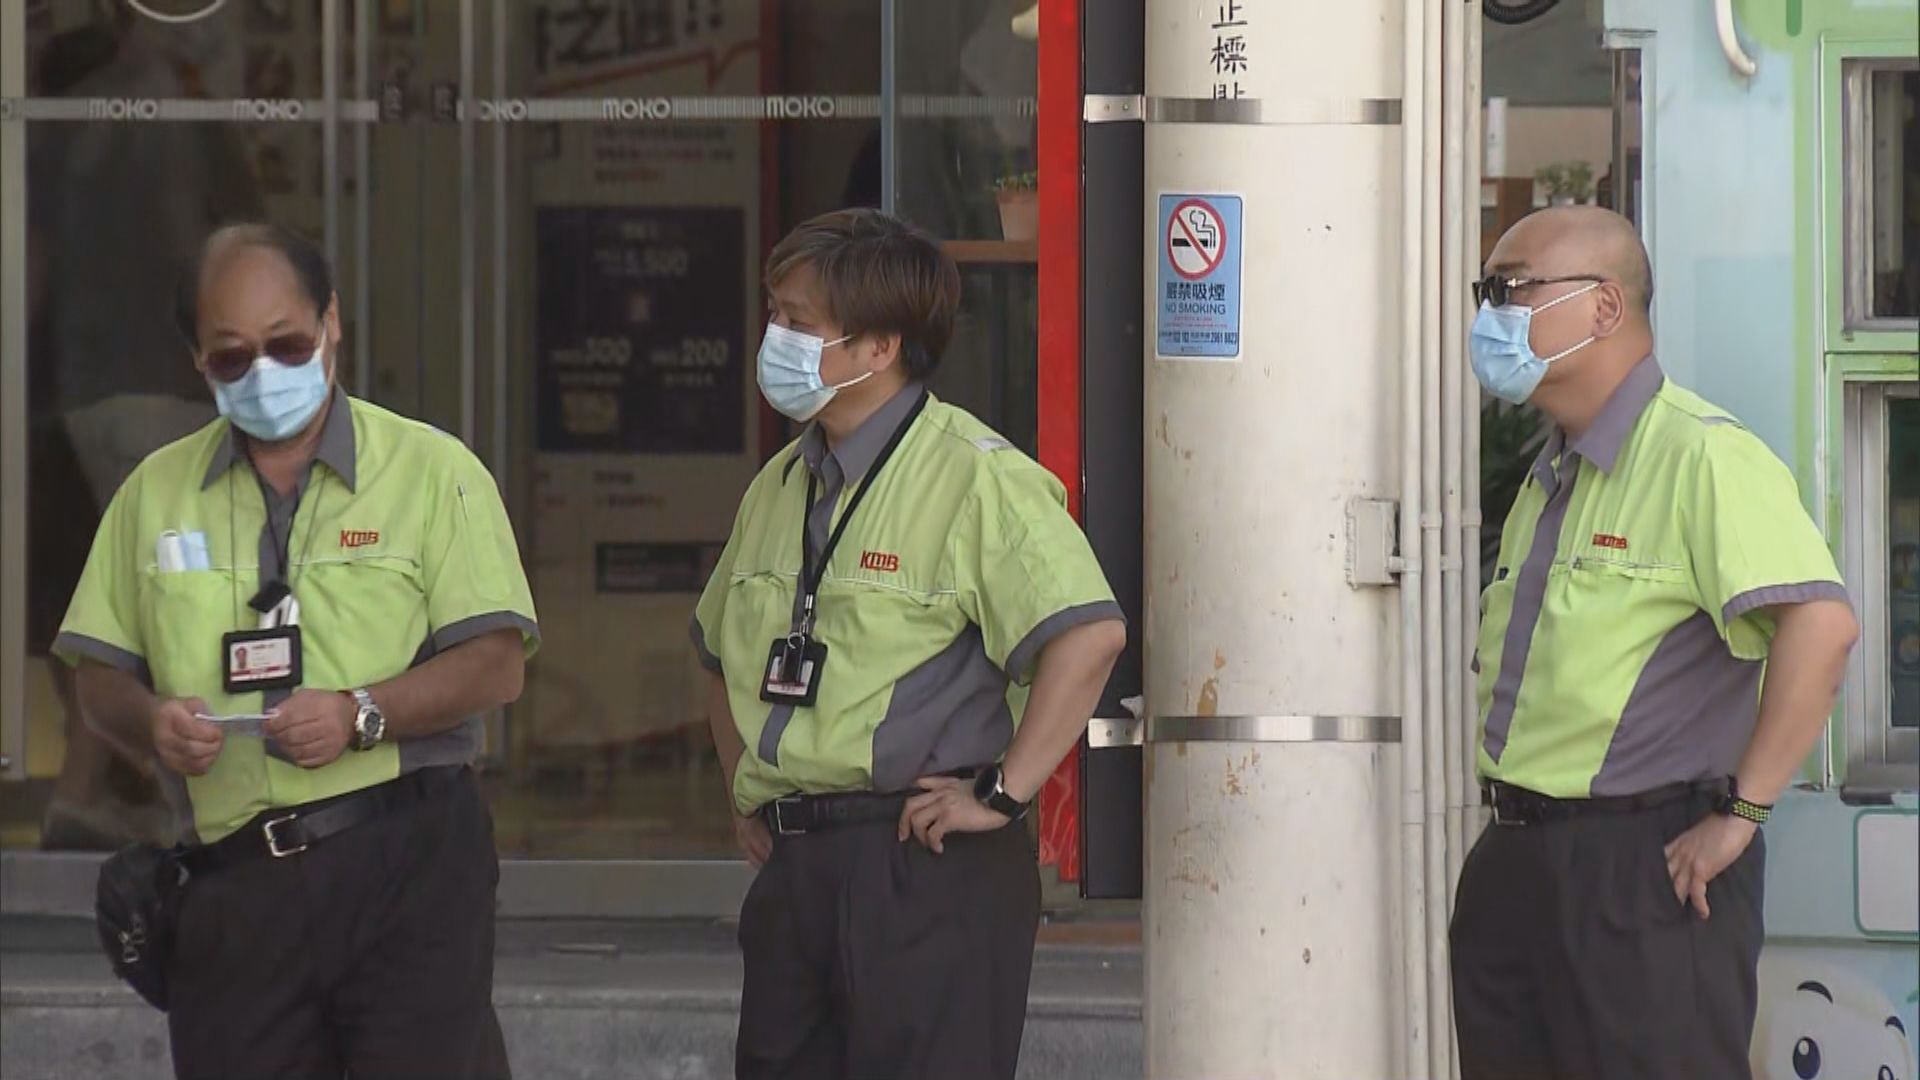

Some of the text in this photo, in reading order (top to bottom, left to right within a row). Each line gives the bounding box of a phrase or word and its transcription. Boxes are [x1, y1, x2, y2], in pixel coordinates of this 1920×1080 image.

[89, 98, 157, 120] MOKO
[234, 98, 304, 120] MOKO
[481, 98, 527, 120] OKO
[603, 97, 672, 119] MOKO
[766, 96, 834, 119] MOKO
[1165, 302, 1226, 315] NO SMOKING
[340, 530, 379, 547] KMB
[860, 550, 899, 572] KMB
